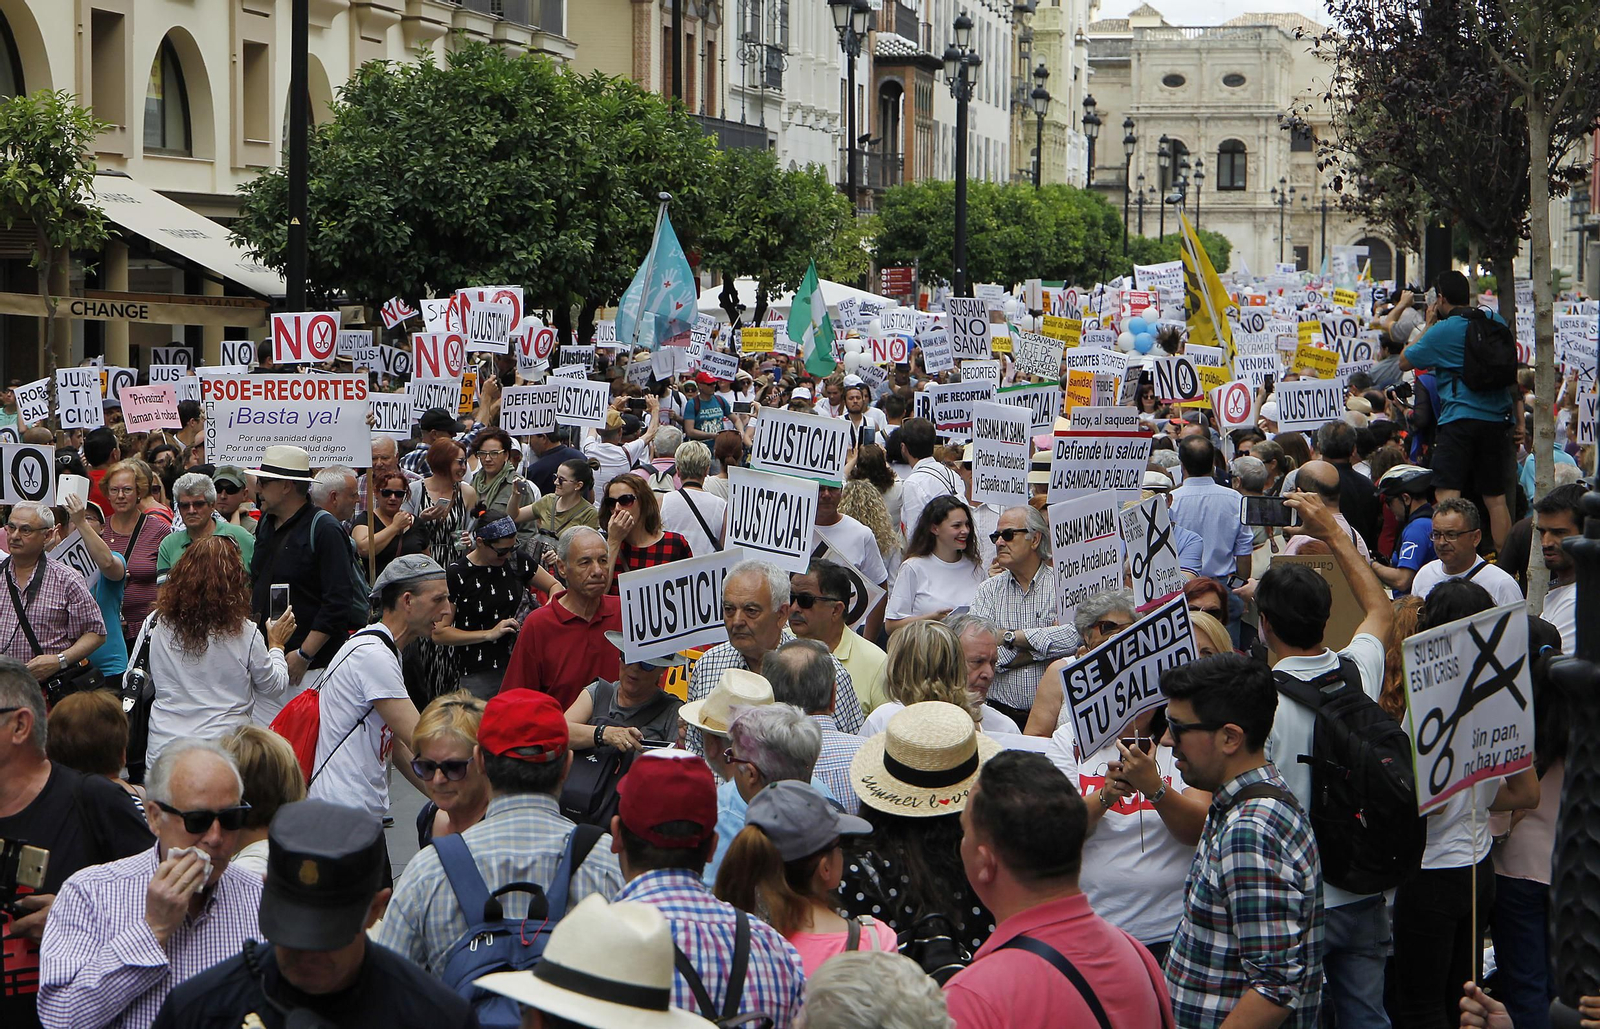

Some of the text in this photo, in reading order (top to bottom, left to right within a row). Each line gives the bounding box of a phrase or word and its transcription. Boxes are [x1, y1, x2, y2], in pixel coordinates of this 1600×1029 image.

[70, 301, 148, 319] CHANGE
[950, 299, 987, 318] SUSANA
[470, 308, 509, 343] ¡JUSTICIA!
[881, 313, 914, 330] ¡JUSTICIA!
[953, 318, 986, 336] NO
[1241, 313, 1265, 334] NO
[1321, 318, 1357, 344] NO
[1560, 320, 1579, 329] LISTAS
[274, 314, 337, 361] NO
[953, 336, 988, 355] SANA
[1087, 334, 1105, 343] LISTAS
[153, 349, 192, 371] NO
[222, 342, 252, 366] NO
[379, 346, 410, 375] NO
[415, 334, 464, 378] NO
[560, 349, 594, 366] ¡Justicia!
[872, 338, 906, 362] NO
[1067, 354, 1100, 368] RECORTES
[1336, 338, 1371, 363] NO
[962, 366, 997, 380] RECORTES
[1239, 357, 1275, 371] VENDEN
[202, 379, 366, 400] PSOE=RECORTES
[1156, 358, 1198, 400] NO
[503, 390, 557, 409] ¡DEFIENDE
[934, 389, 991, 407] ¡ME RECORTAN
[1278, 388, 1341, 420] ¡JUSTICIA!
[228, 407, 341, 428] ¡Basta ya!
[502, 409, 556, 430] TU SALUD!
[938, 408, 971, 421] SALUD y
[1072, 413, 1138, 429] Hoy, al saquear
[238, 434, 254, 442] Por
[273, 434, 307, 442] sanidad
[309, 434, 332, 444] digna
[976, 418, 999, 440] SUSANA
[1000, 420, 1009, 441] NO
[323, 445, 346, 453] digno
[756, 419, 845, 472] ¡JUSTICIA!
[1056, 440, 1149, 460] Defiende tu salud:
[318, 455, 353, 463] primaria
[975, 449, 1025, 471] ¡Pobre Andalucía
[0, 447, 49, 501] O
[975, 473, 1025, 495] y España con Díaz!
[1052, 464, 1140, 491] LA SANIDAD, PÚBLICA.
[730, 484, 811, 551] ¡JUSTICIA!
[1055, 517, 1083, 549] SUSANA
[1084, 513, 1095, 539] NO
[1058, 545, 1117, 587] ¡Pobre Andalucía
[1156, 567, 1167, 581] Sin
[1060, 592, 1065, 607] y
[1065, 582, 1087, 607] España
[1070, 606, 1188, 700] SE VENDE
[1415, 630, 1453, 666] SU BOTÍN
[1410, 668, 1423, 693] ES
[1423, 666, 1433, 688] MI
[1078, 695, 1109, 744] TU
[1490, 724, 1519, 749] pan,
[1477, 743, 1528, 772] hay paz.
